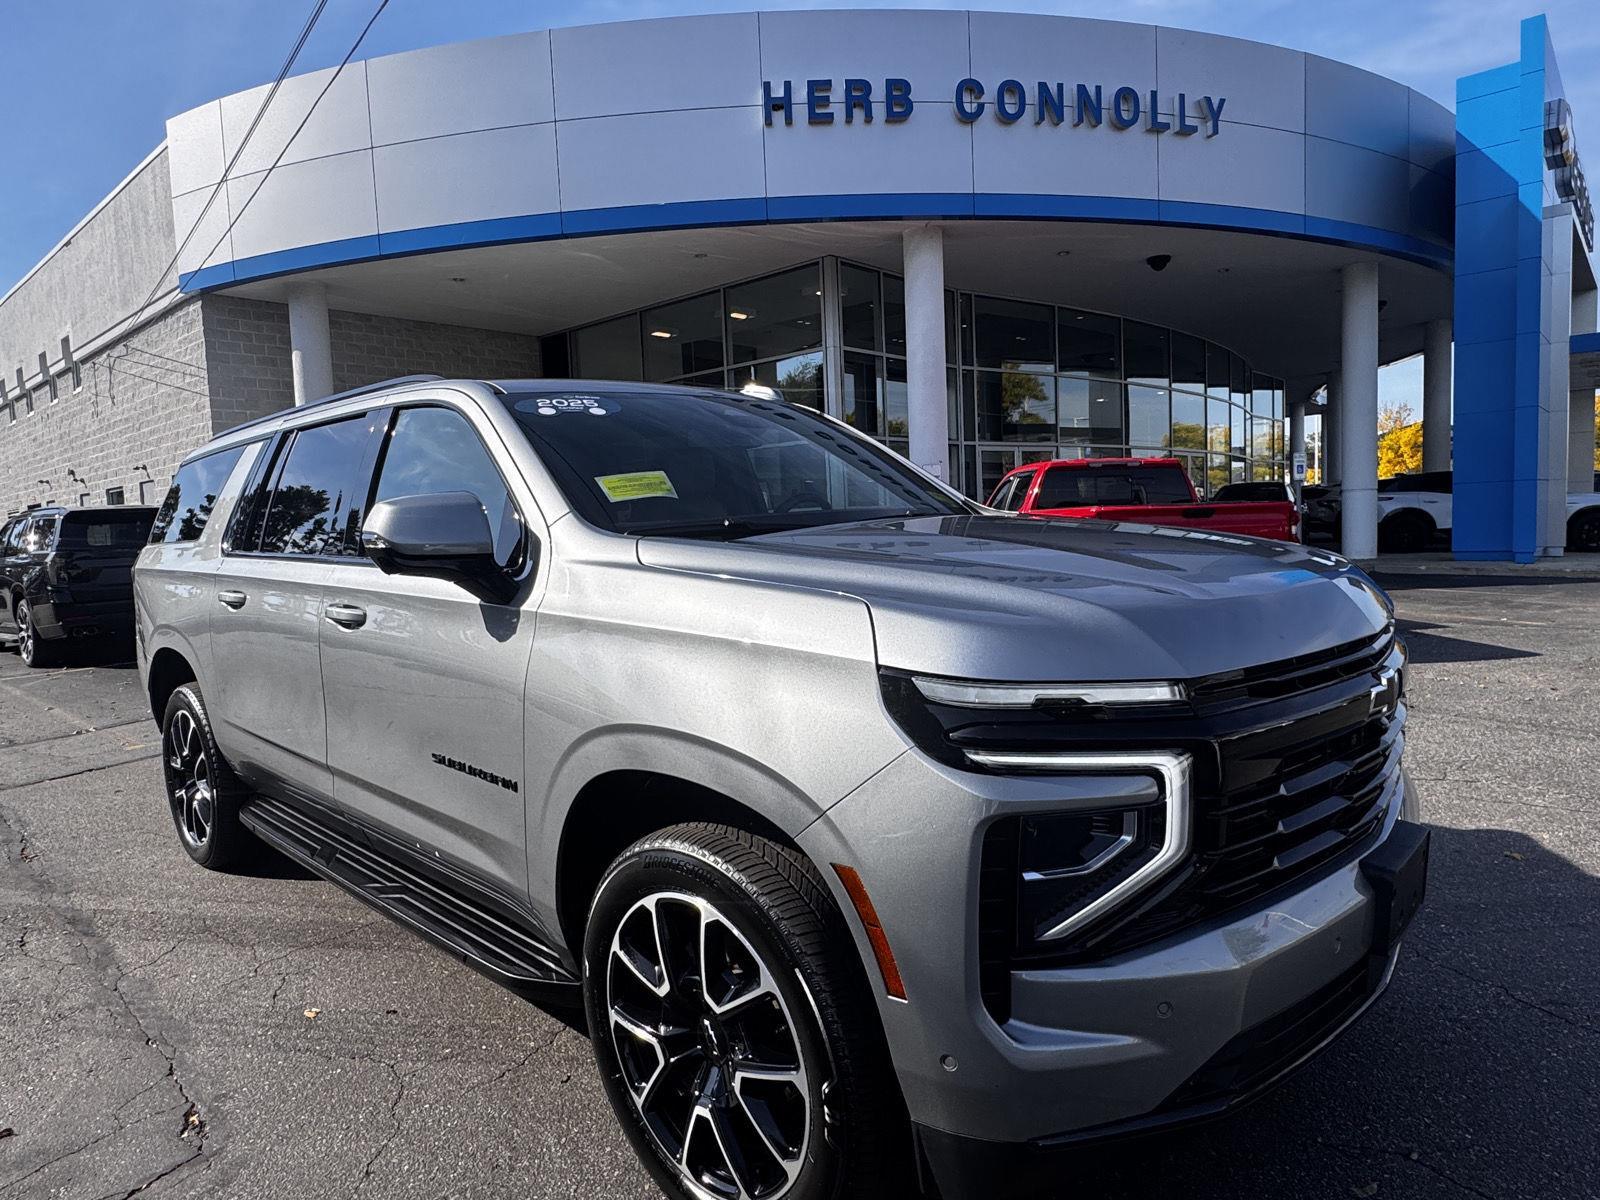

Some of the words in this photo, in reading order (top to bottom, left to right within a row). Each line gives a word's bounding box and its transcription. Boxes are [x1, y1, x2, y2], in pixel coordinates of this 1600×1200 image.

[763, 78, 914, 126] HERB
[954, 78, 1227, 139] CONNOLLY
[536, 398, 599, 408] 2025
[431, 752, 519, 794] SUBURBAN
